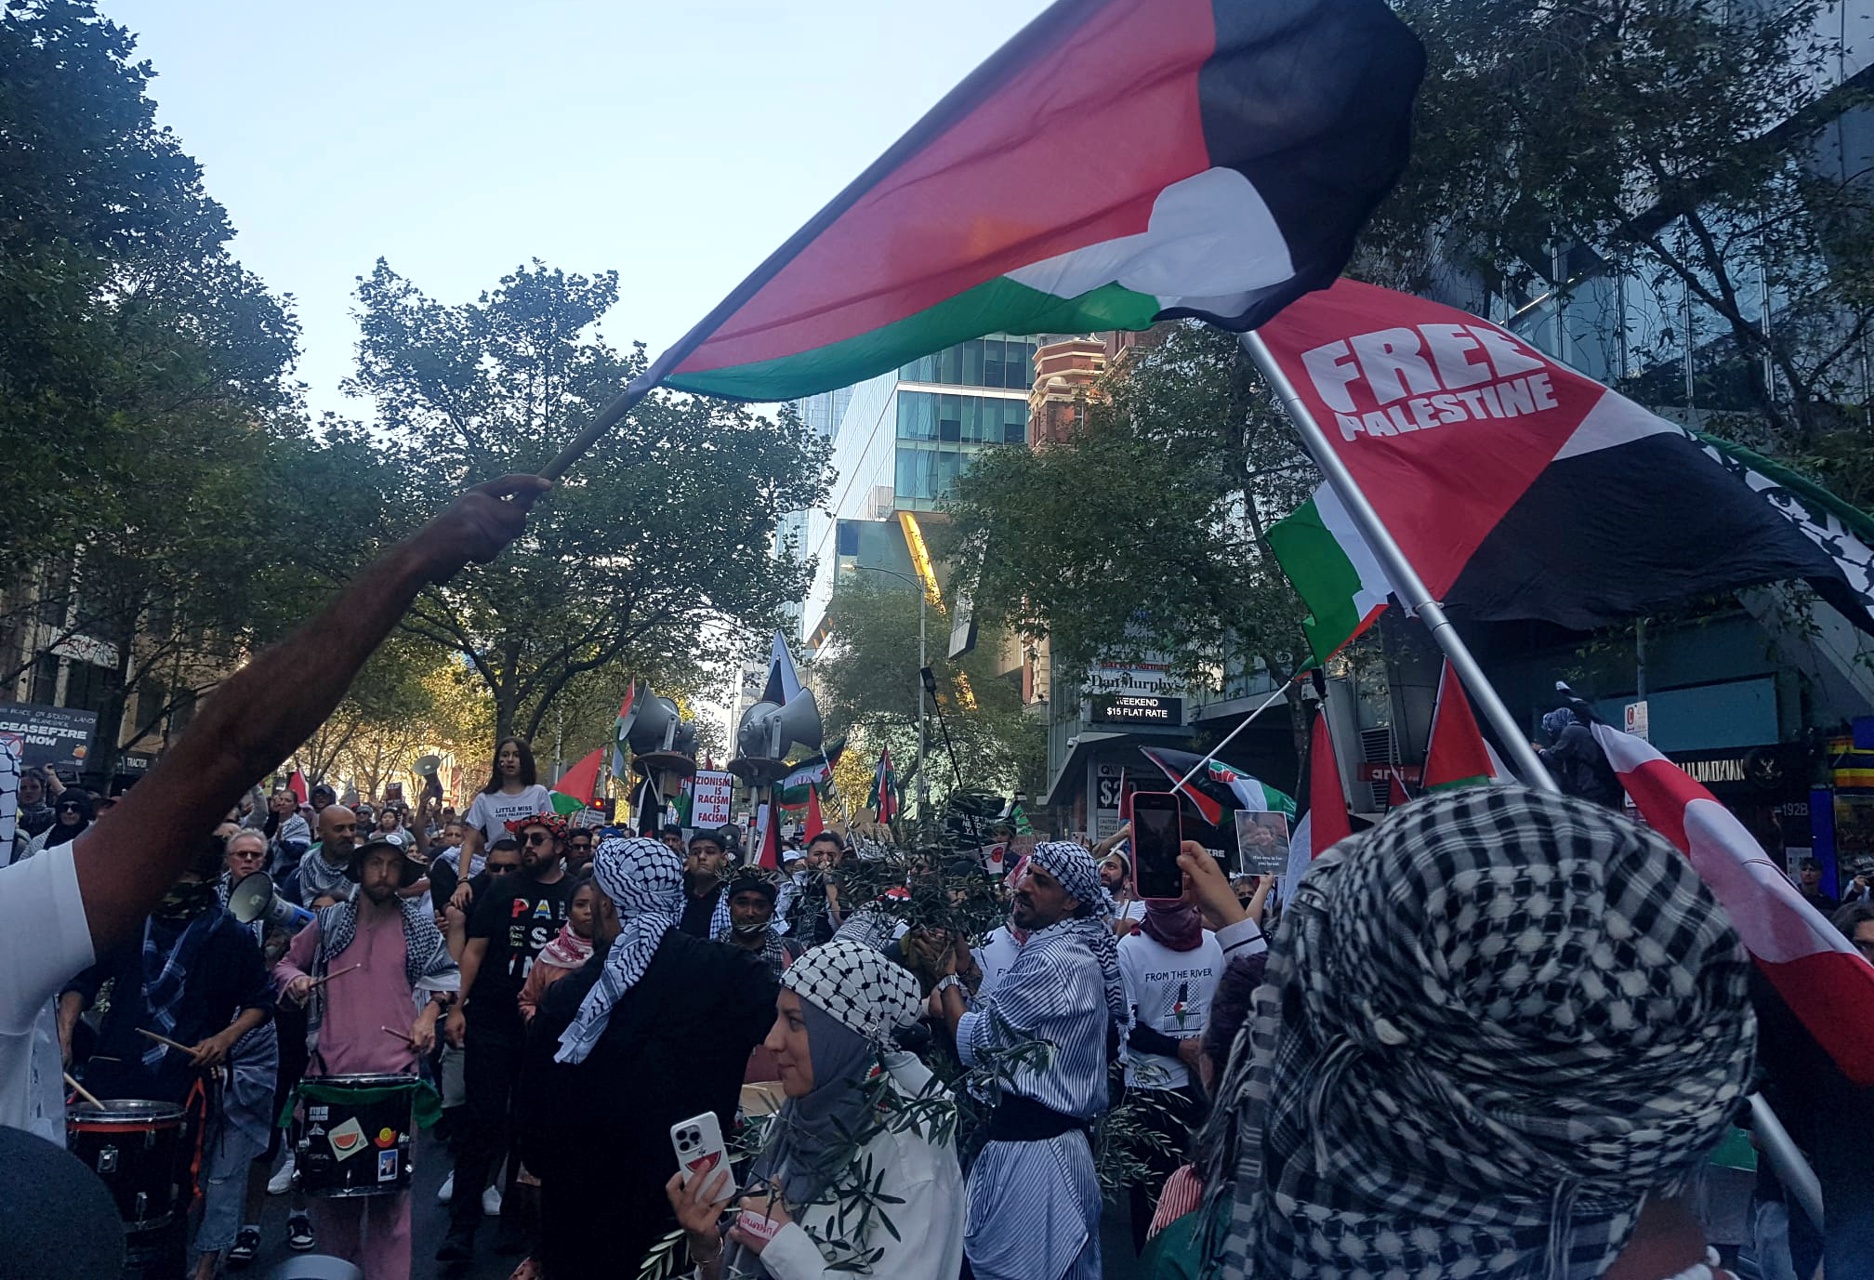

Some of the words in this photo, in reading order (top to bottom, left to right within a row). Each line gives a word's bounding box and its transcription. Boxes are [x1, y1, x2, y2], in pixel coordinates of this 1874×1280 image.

[1301, 324, 1546, 414] FREE
[1334, 373, 1558, 442] PALESTINE
[1106, 707, 1122, 716] $15
[1123, 708, 1143, 717] FLAT
[1145, 709, 1168, 718] RATE
[0, 721, 88, 740] CEASEFIRE
[25, 735, 57, 747] NOW
[696, 776, 731, 787] ZIONISM
[715, 787, 722, 796] IS
[698, 794, 729, 804] RACISM
[713, 805, 720, 813] IS
[698, 812, 727, 823] FACISM
[1145, 971, 1170, 983] FROM
[1170, 970, 1188, 980] THE
[1190, 968, 1213, 979] RIVER
